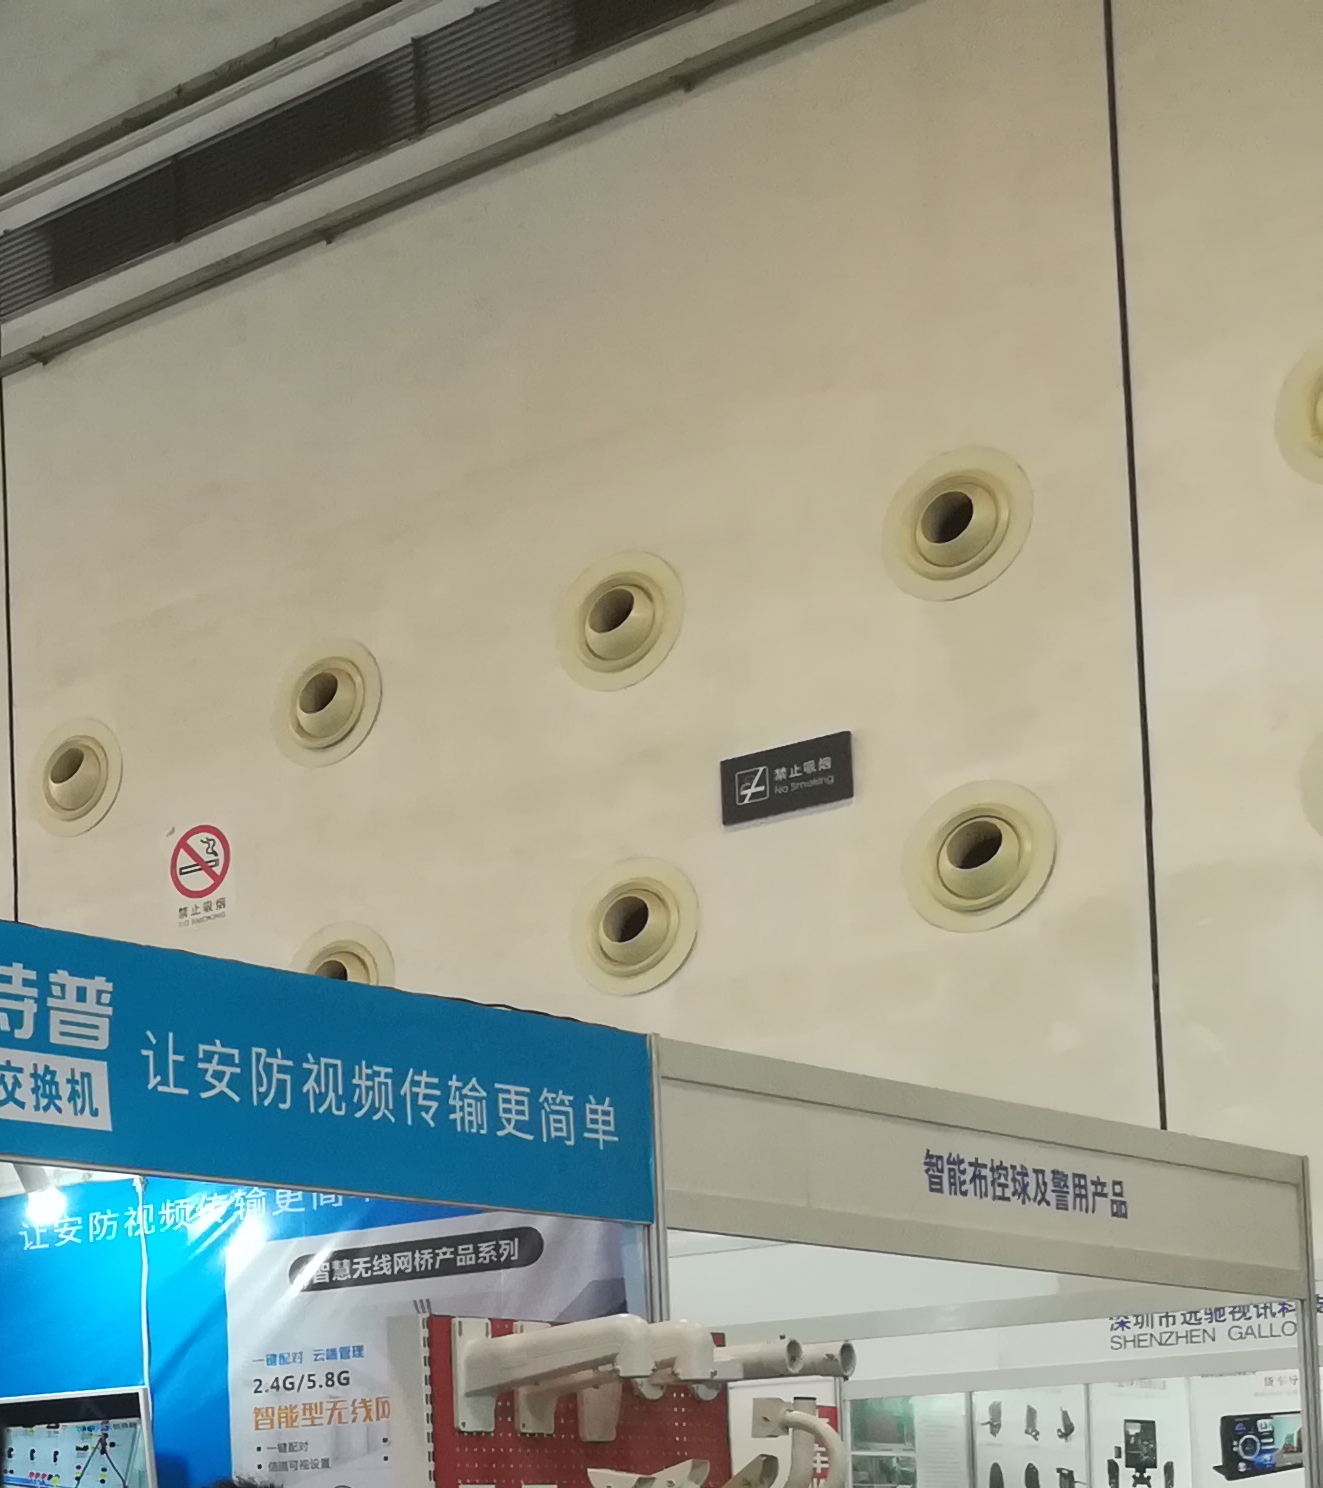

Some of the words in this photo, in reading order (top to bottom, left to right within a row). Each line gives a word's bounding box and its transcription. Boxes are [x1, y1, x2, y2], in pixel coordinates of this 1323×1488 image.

[774, 756, 833, 781] 禁止吸烟
[774, 784, 789, 795] No
[790, 775, 835, 792] Smoking
[140, 1030, 620, 1151] 让安防视频传输更简单
[923, 1148, 1129, 1220] 智能布控球及警用产品
[1110, 1327, 1216, 1351] SHENZHEN
[253, 1370, 350, 1394] 2.4G/5.8G
